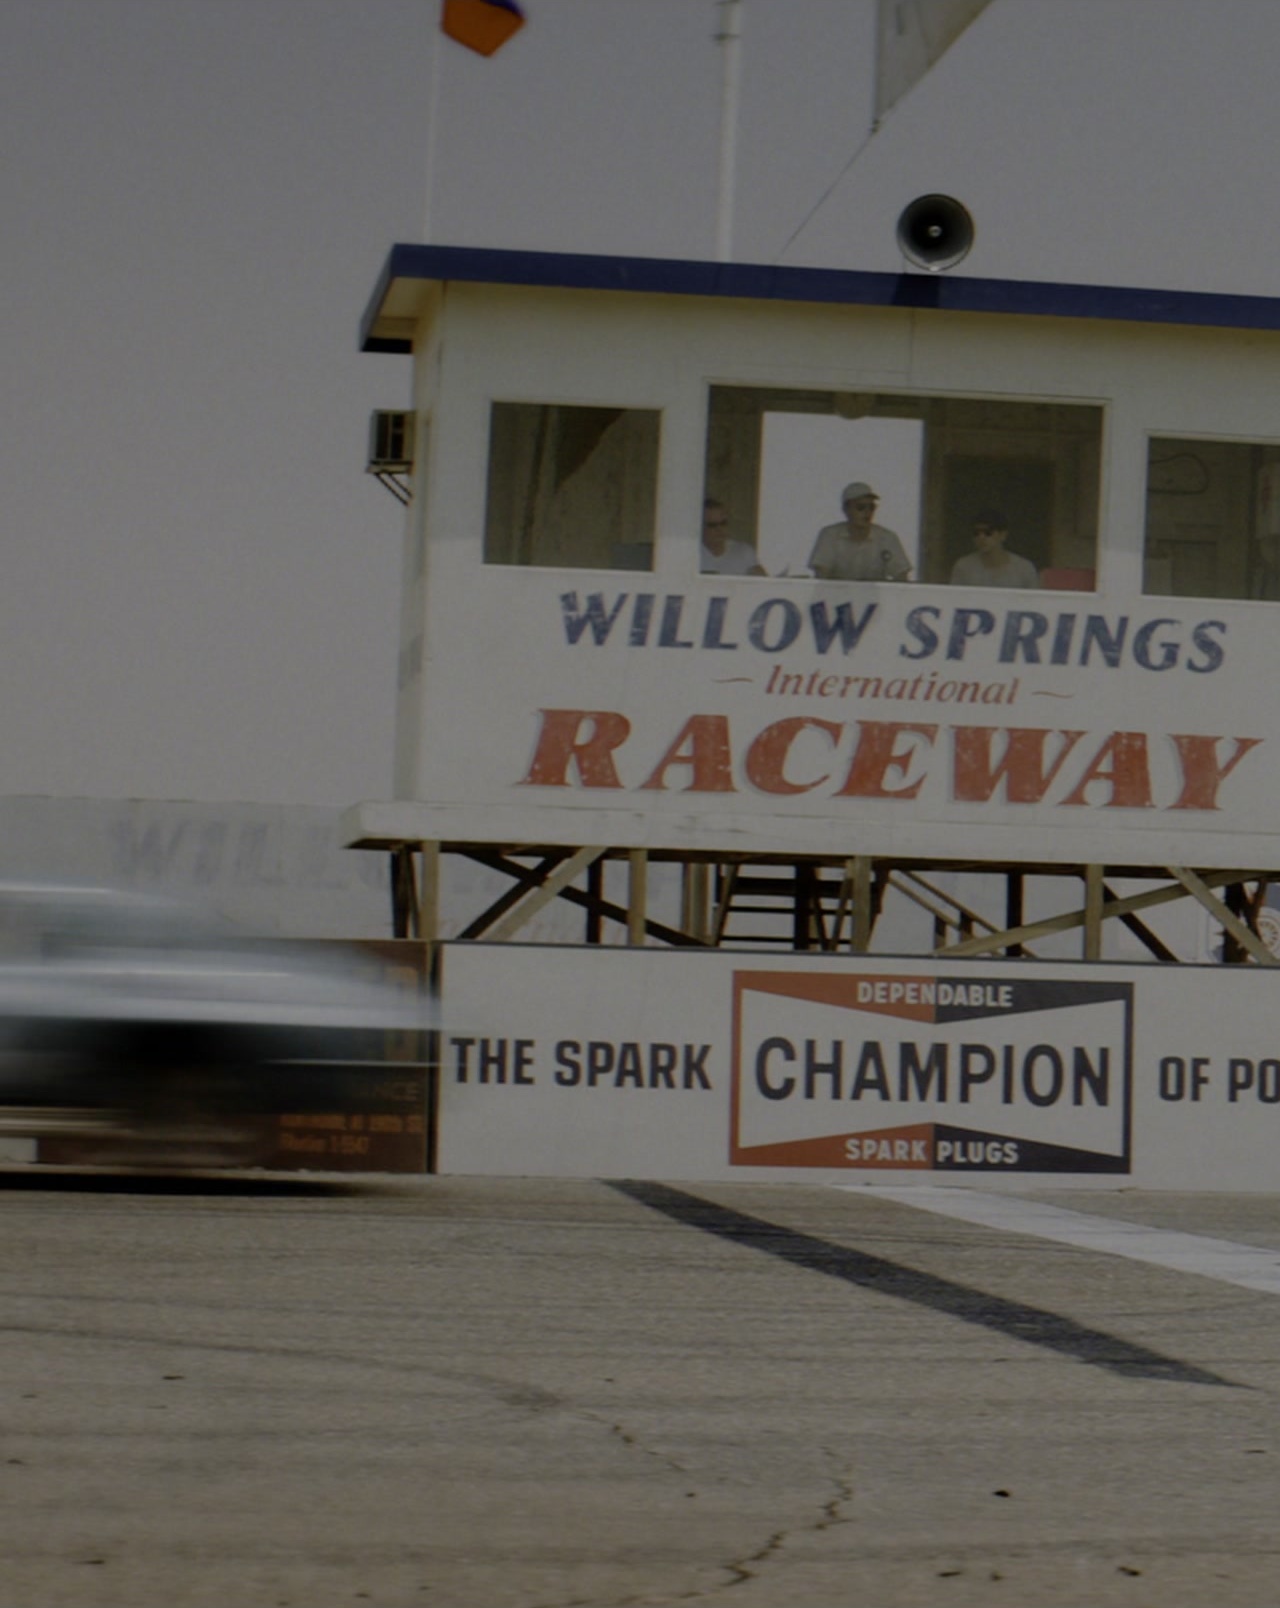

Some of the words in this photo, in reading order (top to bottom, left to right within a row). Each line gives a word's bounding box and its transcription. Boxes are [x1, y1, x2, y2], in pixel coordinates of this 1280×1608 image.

[560, 590, 877, 655] WILLOW
[900, 605, 1228, 675] SPRINGS
[766, 664, 1019, 707] International
[513, 708, 1264, 811] RACEWAY
[856, 981, 1014, 1009] DEPENDABLE
[451, 1036, 534, 1086] THE
[554, 1041, 713, 1091] SPARK
[755, 1037, 1110, 1108] CHAMPION
[1158, 1055, 1209, 1103] OF
[845, 1138, 926, 1163] SPARK
[937, 1139, 1018, 1166] PLUGS
